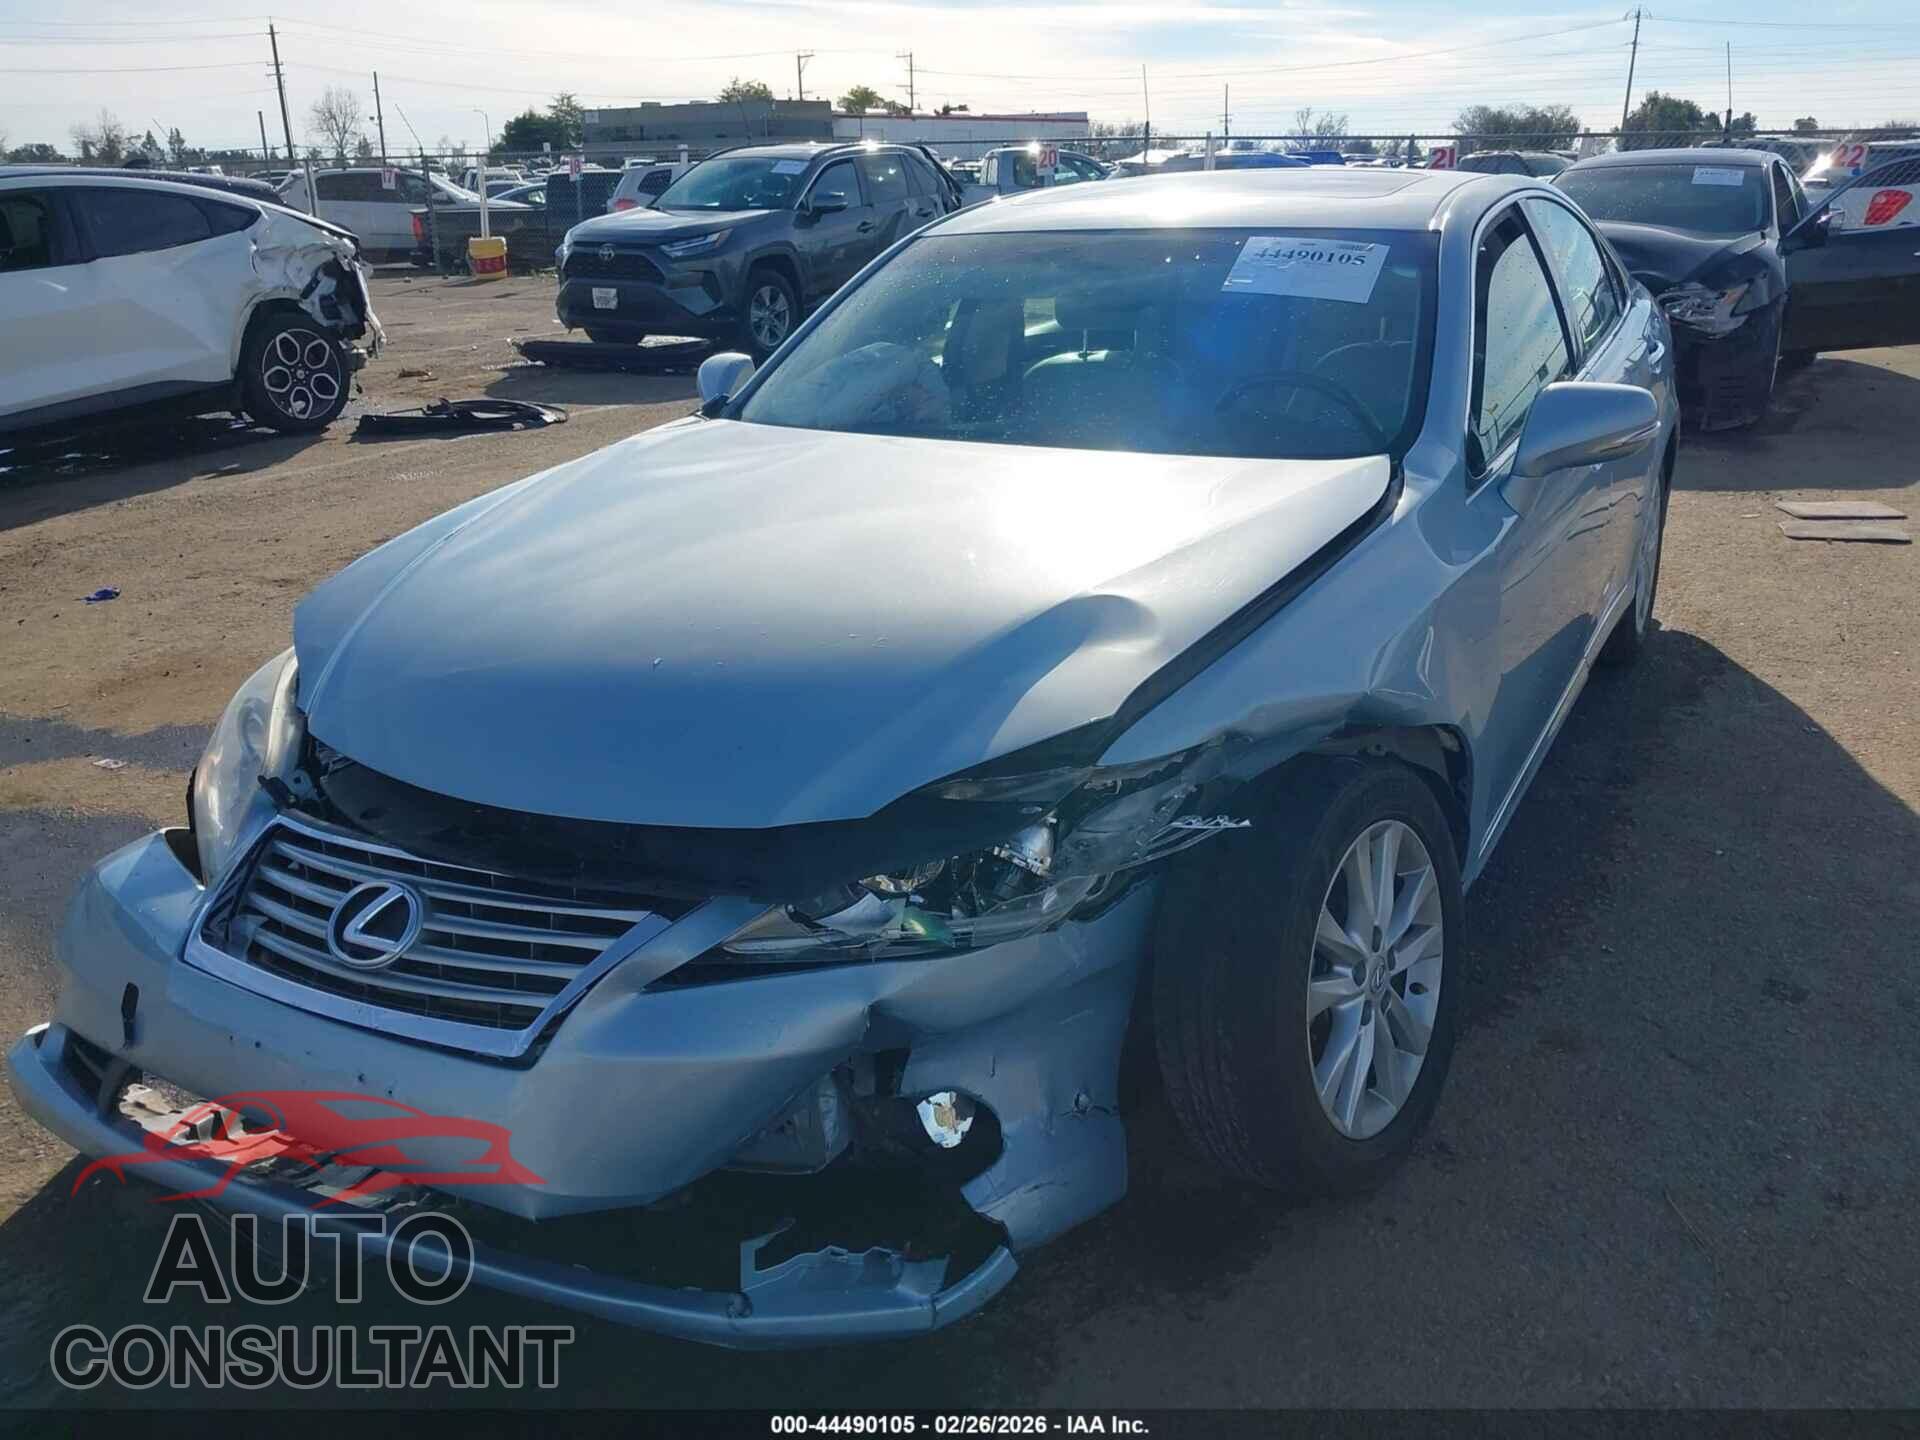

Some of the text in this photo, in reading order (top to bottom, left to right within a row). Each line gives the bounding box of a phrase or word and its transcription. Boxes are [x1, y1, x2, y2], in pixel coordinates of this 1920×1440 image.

[1039, 149, 1057, 168] 20
[1430, 147, 1456, 169] 21
[1254, 247, 1367, 265] 44490105
